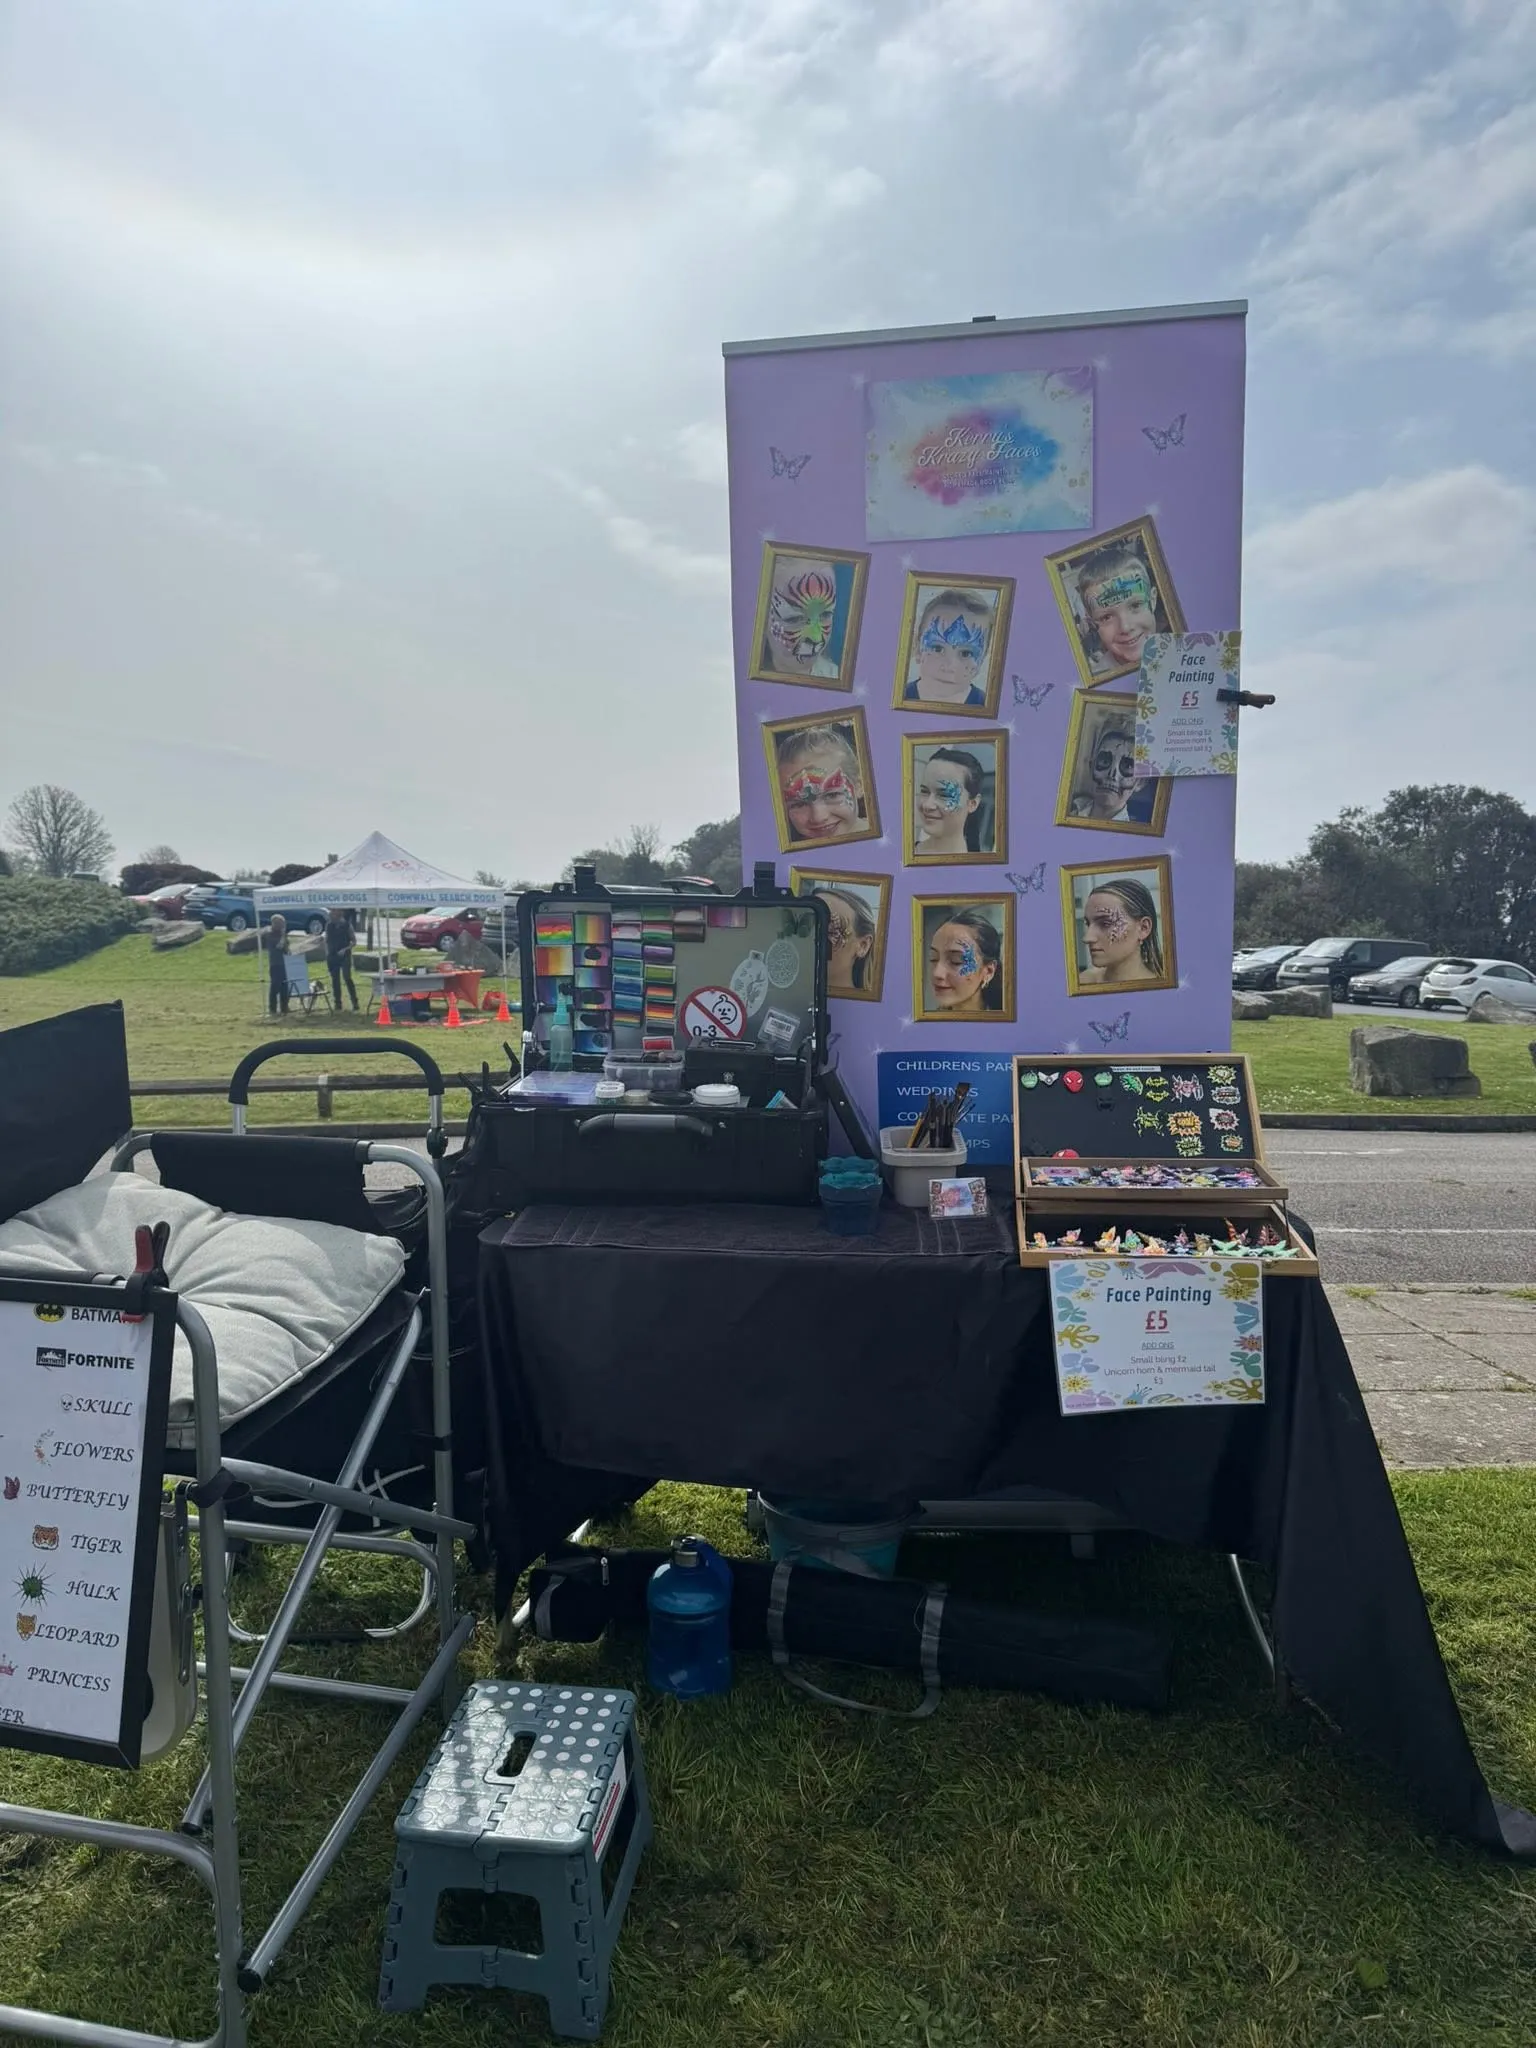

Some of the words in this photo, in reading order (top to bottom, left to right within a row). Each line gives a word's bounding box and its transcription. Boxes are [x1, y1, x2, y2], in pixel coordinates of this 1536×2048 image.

[918, 445, 980, 469] Krazy
[987, 442, 1041, 461] Faces
[1180, 654, 1206, 666] Face
[1168, 671, 1215, 685] Painting
[1181, 690, 1199, 709] £5
[262, 895, 304, 904] CORNWALL
[308, 893, 340, 903] SEARCH
[342, 893, 368, 902] DOGS
[387, 893, 436, 902] CORNWALL
[439, 893, 472, 902] SEARCH
[474, 893, 497, 902] DOGS
[896, 1061, 981, 1072] CHILDRENS
[1106, 1287, 1140, 1303] Face
[1146, 1286, 1212, 1306] Painting
[71, 1308, 126, 1324] BATMA
[1145, 1310, 1169, 1334] £5
[1141, 1342, 1157, 1350] ADD
[1158, 1341, 1175, 1350] ONS
[67, 1353, 135, 1370] FORTNITE
[1130, 1356, 1153, 1364] Small
[1155, 1355, 1176, 1364] bling
[1177, 1354, 1187, 1363] £2
[1104, 1367, 1135, 1377] Unicorn
[1136, 1366, 1155, 1375] horn
[1156, 1366, 1163, 1374] &
[1164, 1364, 1202, 1374] mermaid
[1203, 1363, 1216, 1373] tail
[1153, 1376, 1164, 1385] £3
[74, 1398, 132, 1416] SKULL
[50, 1441, 135, 1462] FLOWERS
[26, 1483, 130, 1510] BUTTERFLY
[71, 1534, 123, 1554] TIGER
[65, 1580, 120, 1601] HULK
[34, 1624, 120, 1648] LEOPARD
[27, 1666, 111, 1692] PRINCESS
[0, 1706, 25, 1724] ER
